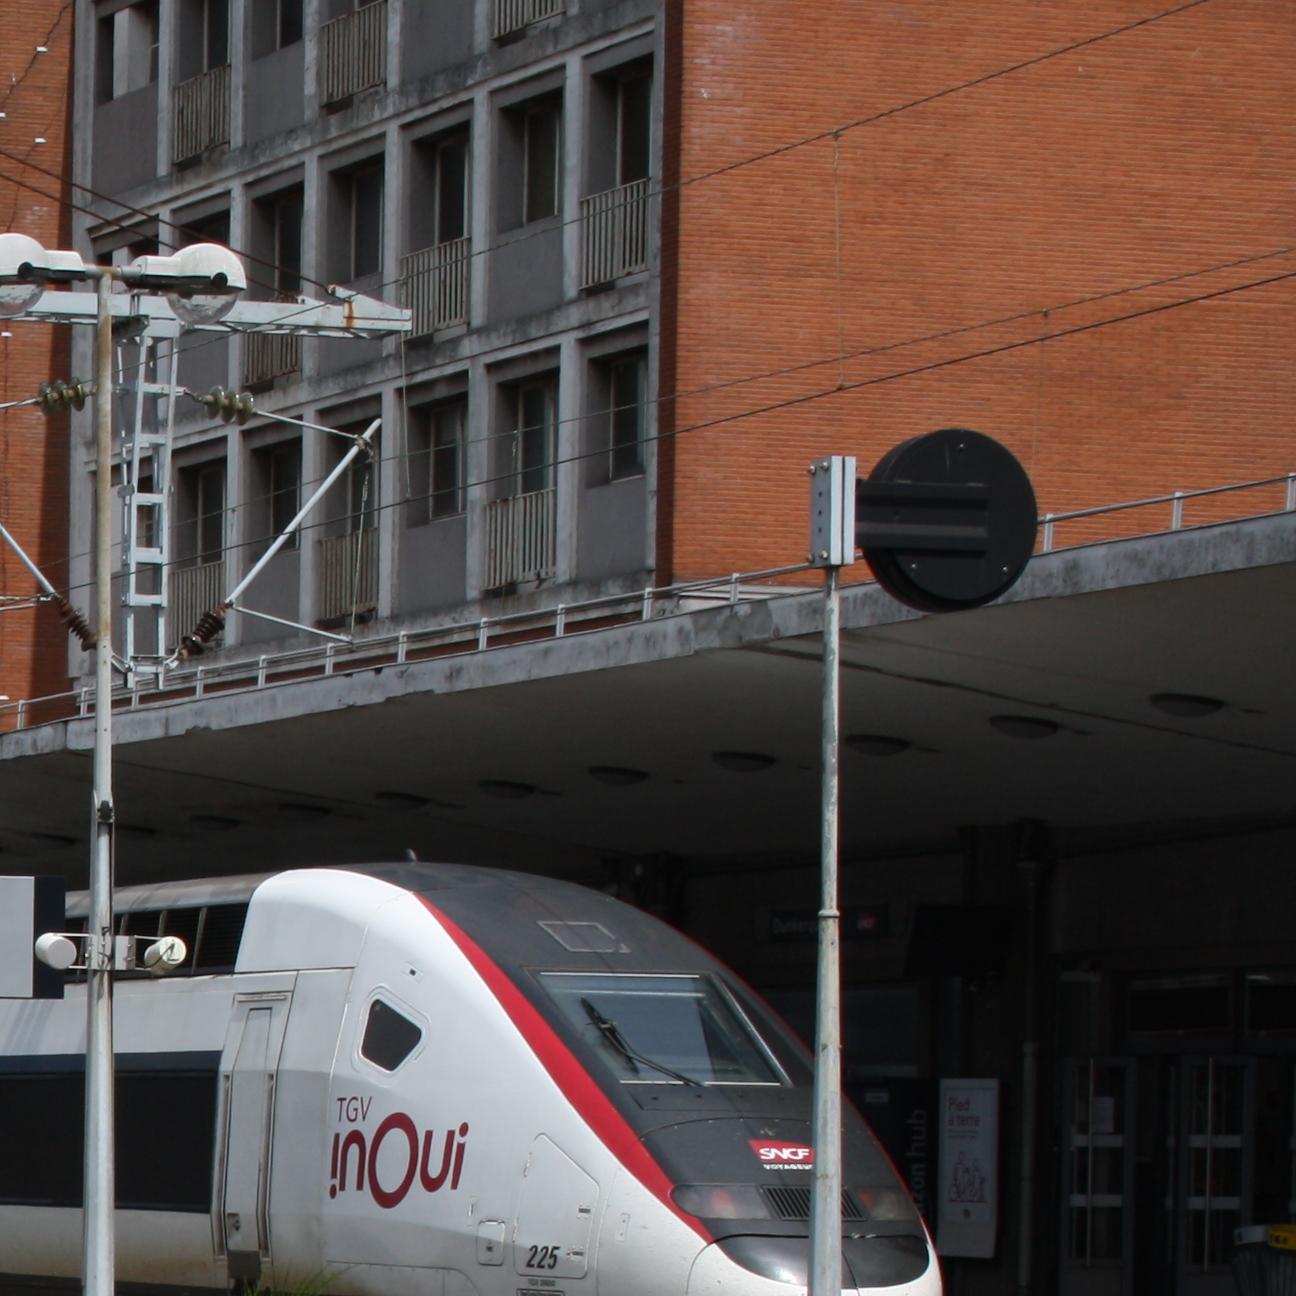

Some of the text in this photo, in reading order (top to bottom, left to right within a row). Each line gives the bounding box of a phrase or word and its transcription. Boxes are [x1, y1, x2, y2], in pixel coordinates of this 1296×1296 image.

[336, 1096, 373, 1122] TGV
[904, 1108, 928, 1157] hub
[759, 1147, 810, 1160] SNCF
[526, 1245, 561, 1270] 225
